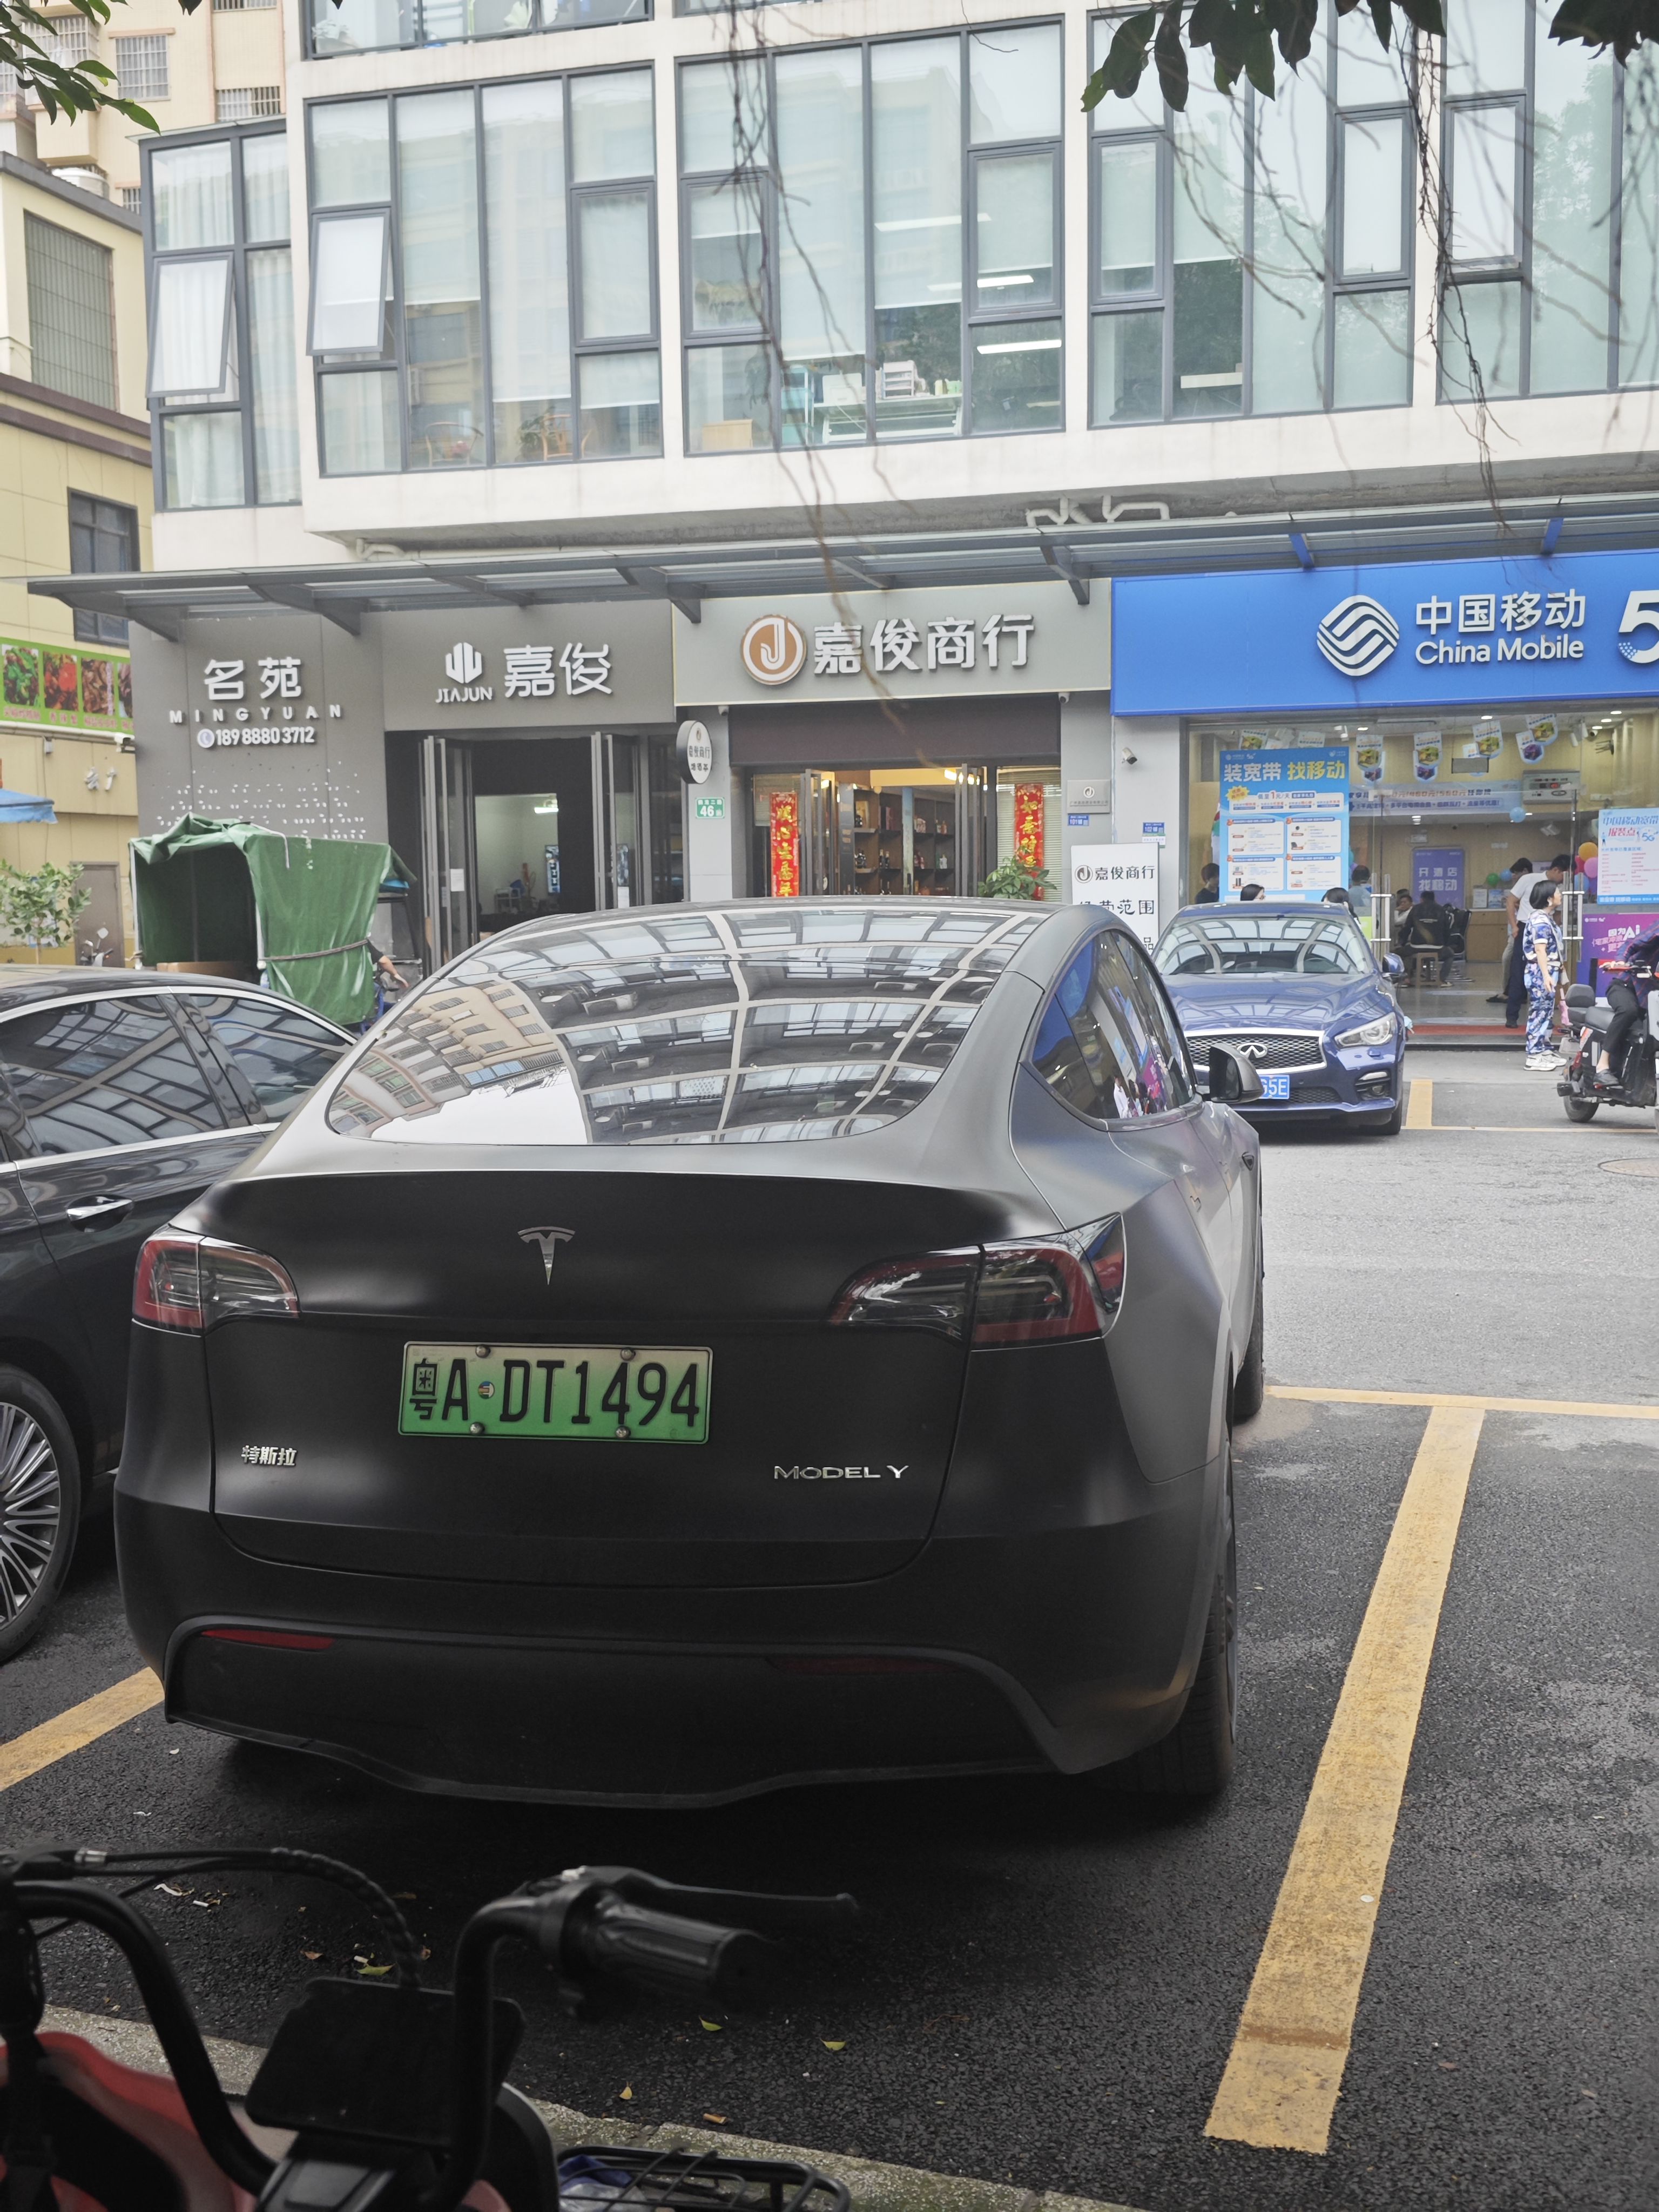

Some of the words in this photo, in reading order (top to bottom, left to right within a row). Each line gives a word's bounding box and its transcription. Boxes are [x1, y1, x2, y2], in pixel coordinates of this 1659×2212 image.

[1415, 588, 1586, 635] 中国移动
[813, 613, 1035, 675] 嘉俊商行
[1415, 639, 1491, 664] China
[1497, 633, 1584, 662] Mobile
[204, 656, 302, 700] 名苑
[503, 642, 613, 698] 嘉俊
[435, 686, 493, 704] JIAJUN
[169, 704, 341, 724] MINGYUAN
[1223, 762, 1282, 783] 装宽带
[1287, 760, 1346, 781] 找移动
[1095, 865, 1155, 881] 嘉俊商行
[240, 1445, 297, 1466] 特斯拉
[774, 1466, 881, 1480] MODEL
[886, 1465, 909, 1479] Y
